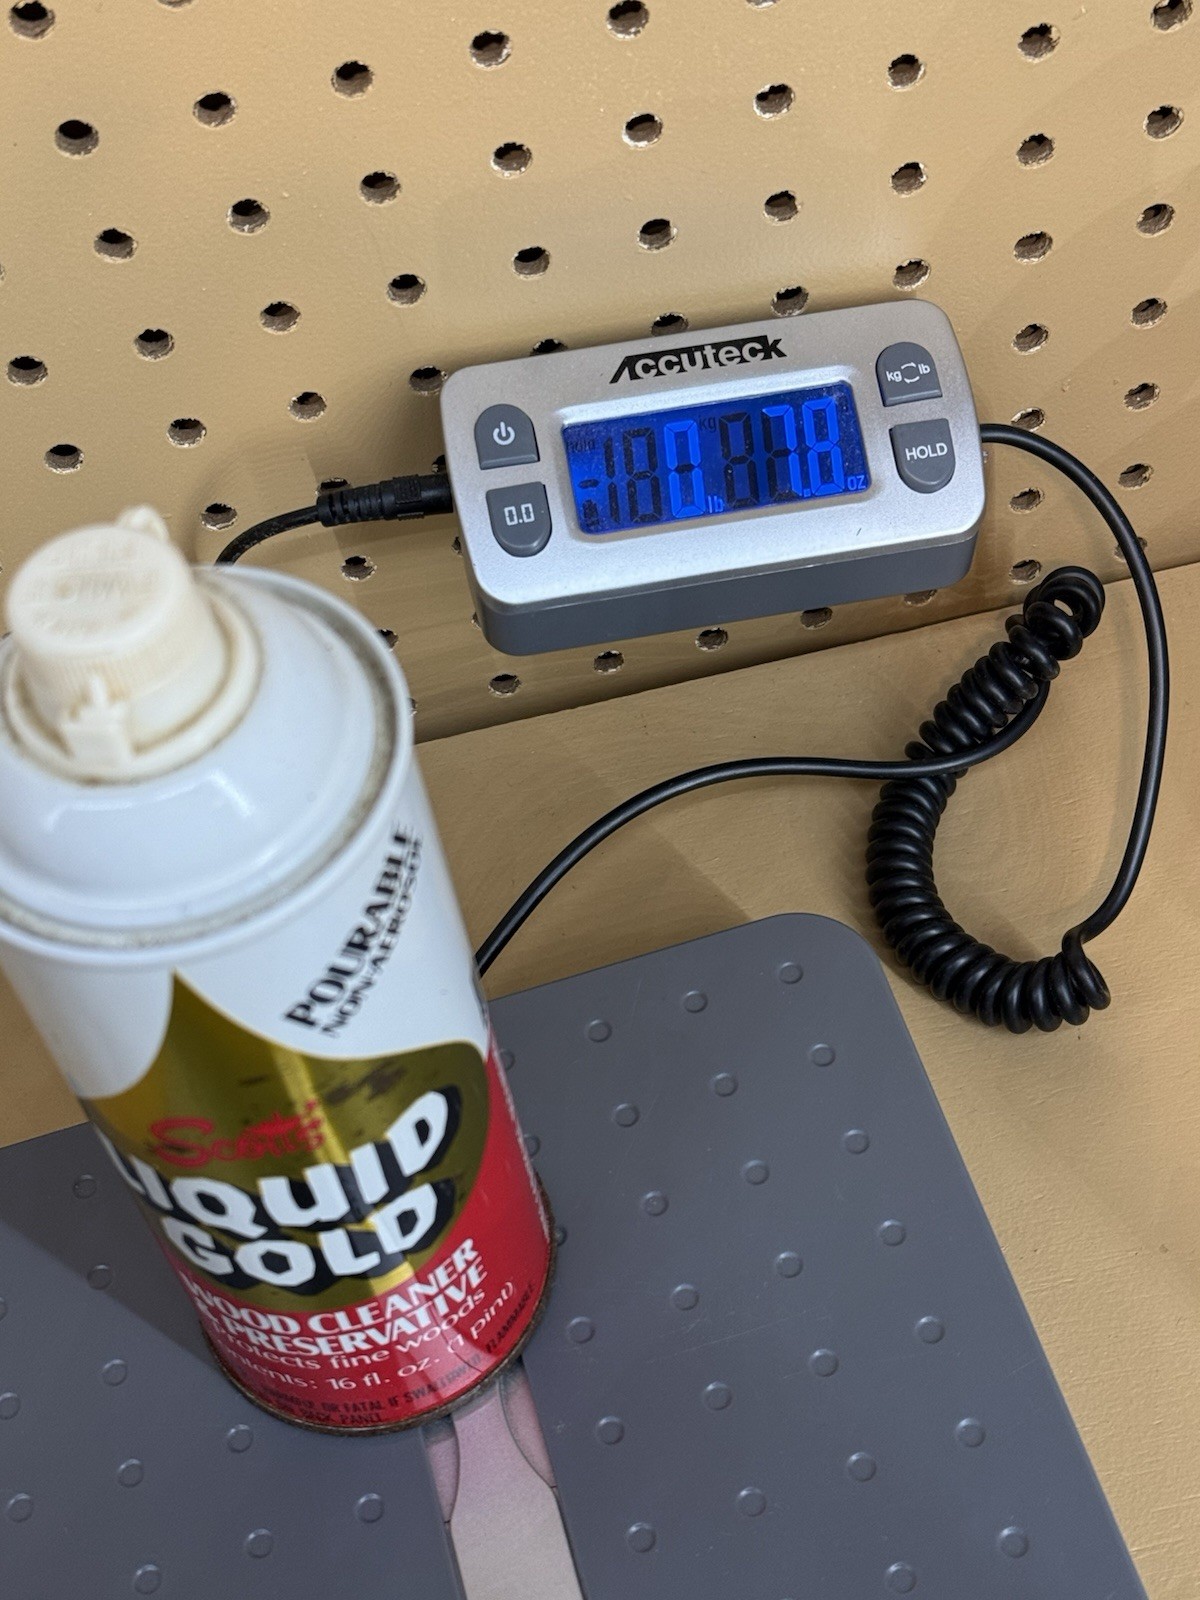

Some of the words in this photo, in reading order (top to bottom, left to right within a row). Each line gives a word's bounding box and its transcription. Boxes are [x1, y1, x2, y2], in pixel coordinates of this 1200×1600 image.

[885, 370, 903, 383] kg
[917, 363, 931, 375] lb
[904, 442, 949, 461] HOLD
[503, 502, 535, 526] 0.0
[284, 824, 414, 1028] POURABLE
[162, 1183, 438, 1287] GOLD
[179, 1270, 301, 1335] WOOD
[307, 1237, 479, 1335] CLEANER
[220, 1255, 488, 1356] PRESERVATIVE
[329, 1349, 390, 1370] fine
[395, 1288, 487, 1353] woods
[325, 1376, 357, 1391] 16
[362, 1371, 391, 1388] fl.
[397, 1355, 441, 1377] oz.
[469, 1280, 515, 1340] pint)
